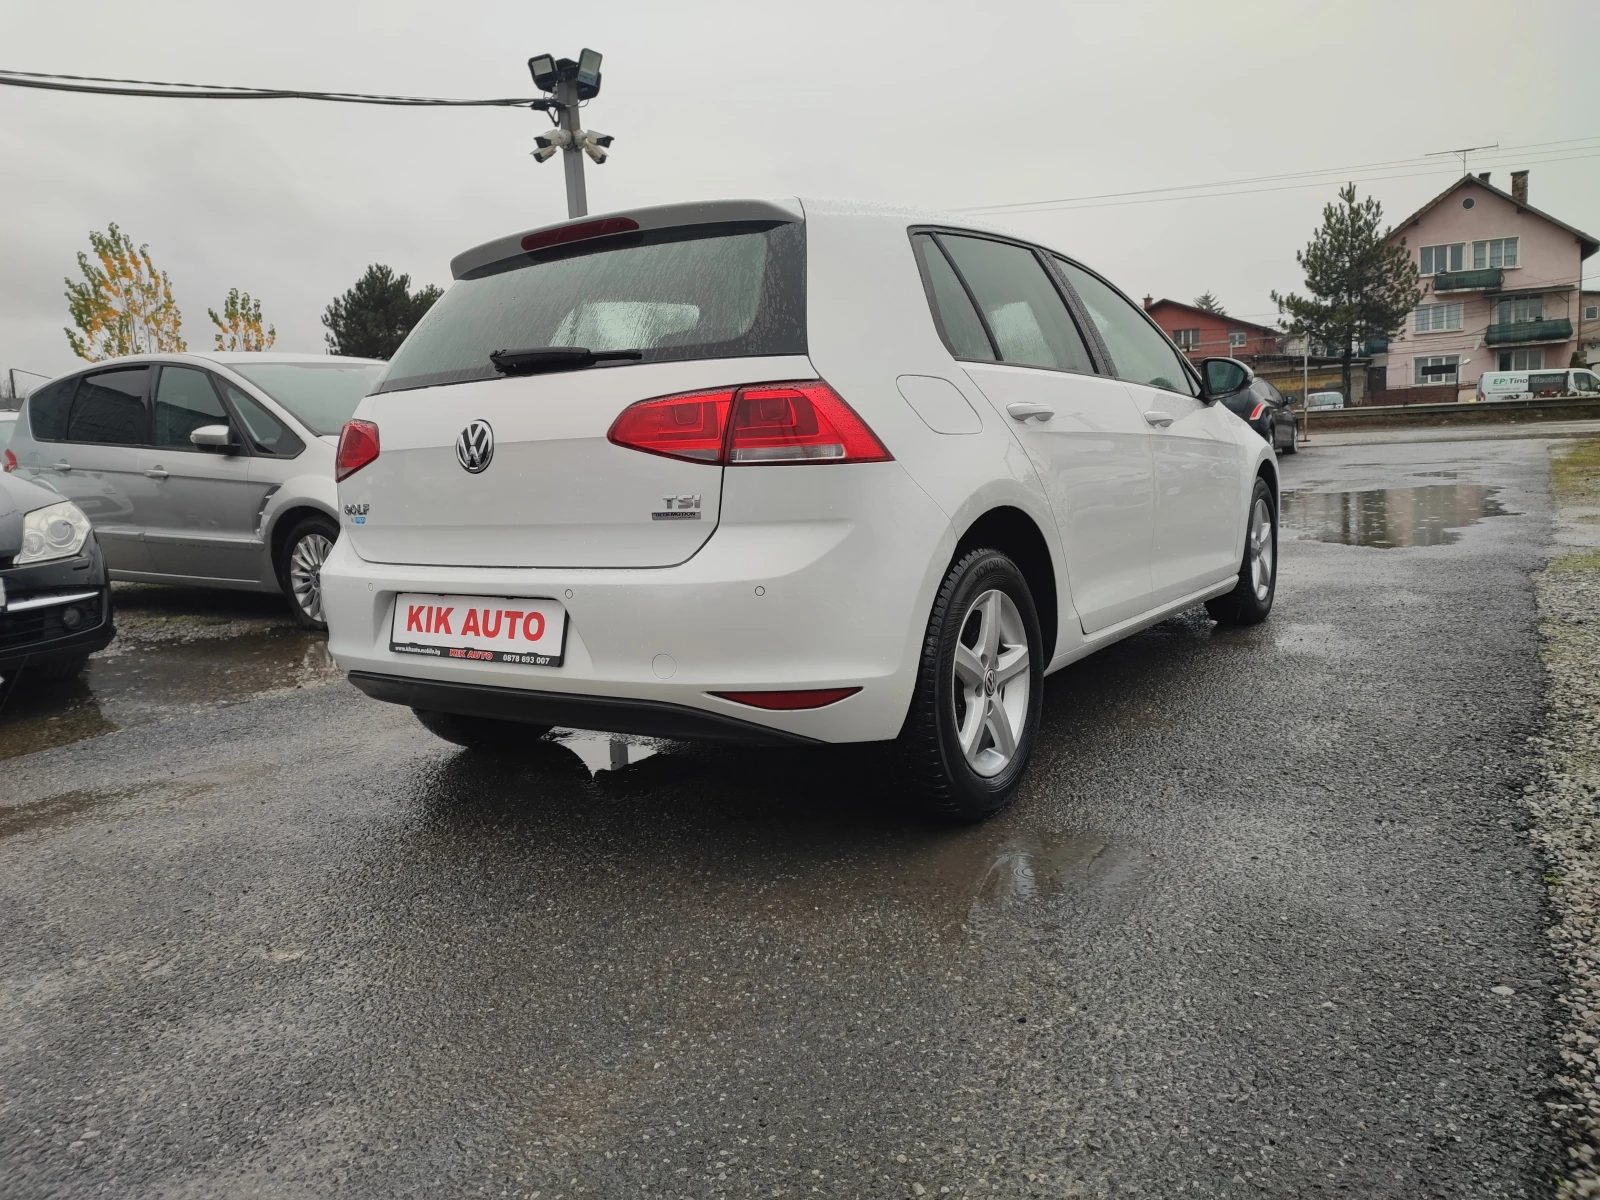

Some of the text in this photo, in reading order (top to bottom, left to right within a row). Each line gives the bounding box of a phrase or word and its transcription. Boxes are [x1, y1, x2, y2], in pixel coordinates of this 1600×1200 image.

[662, 494, 701, 509] TSI
[406, 605, 545, 641] KIK AUTO
[449, 648, 466, 658] KIK
[466, 650, 493, 660] AUTO
[502, 654, 520, 663] 0878
[521, 655, 535, 664] 693
[536, 656, 550, 665] 007
